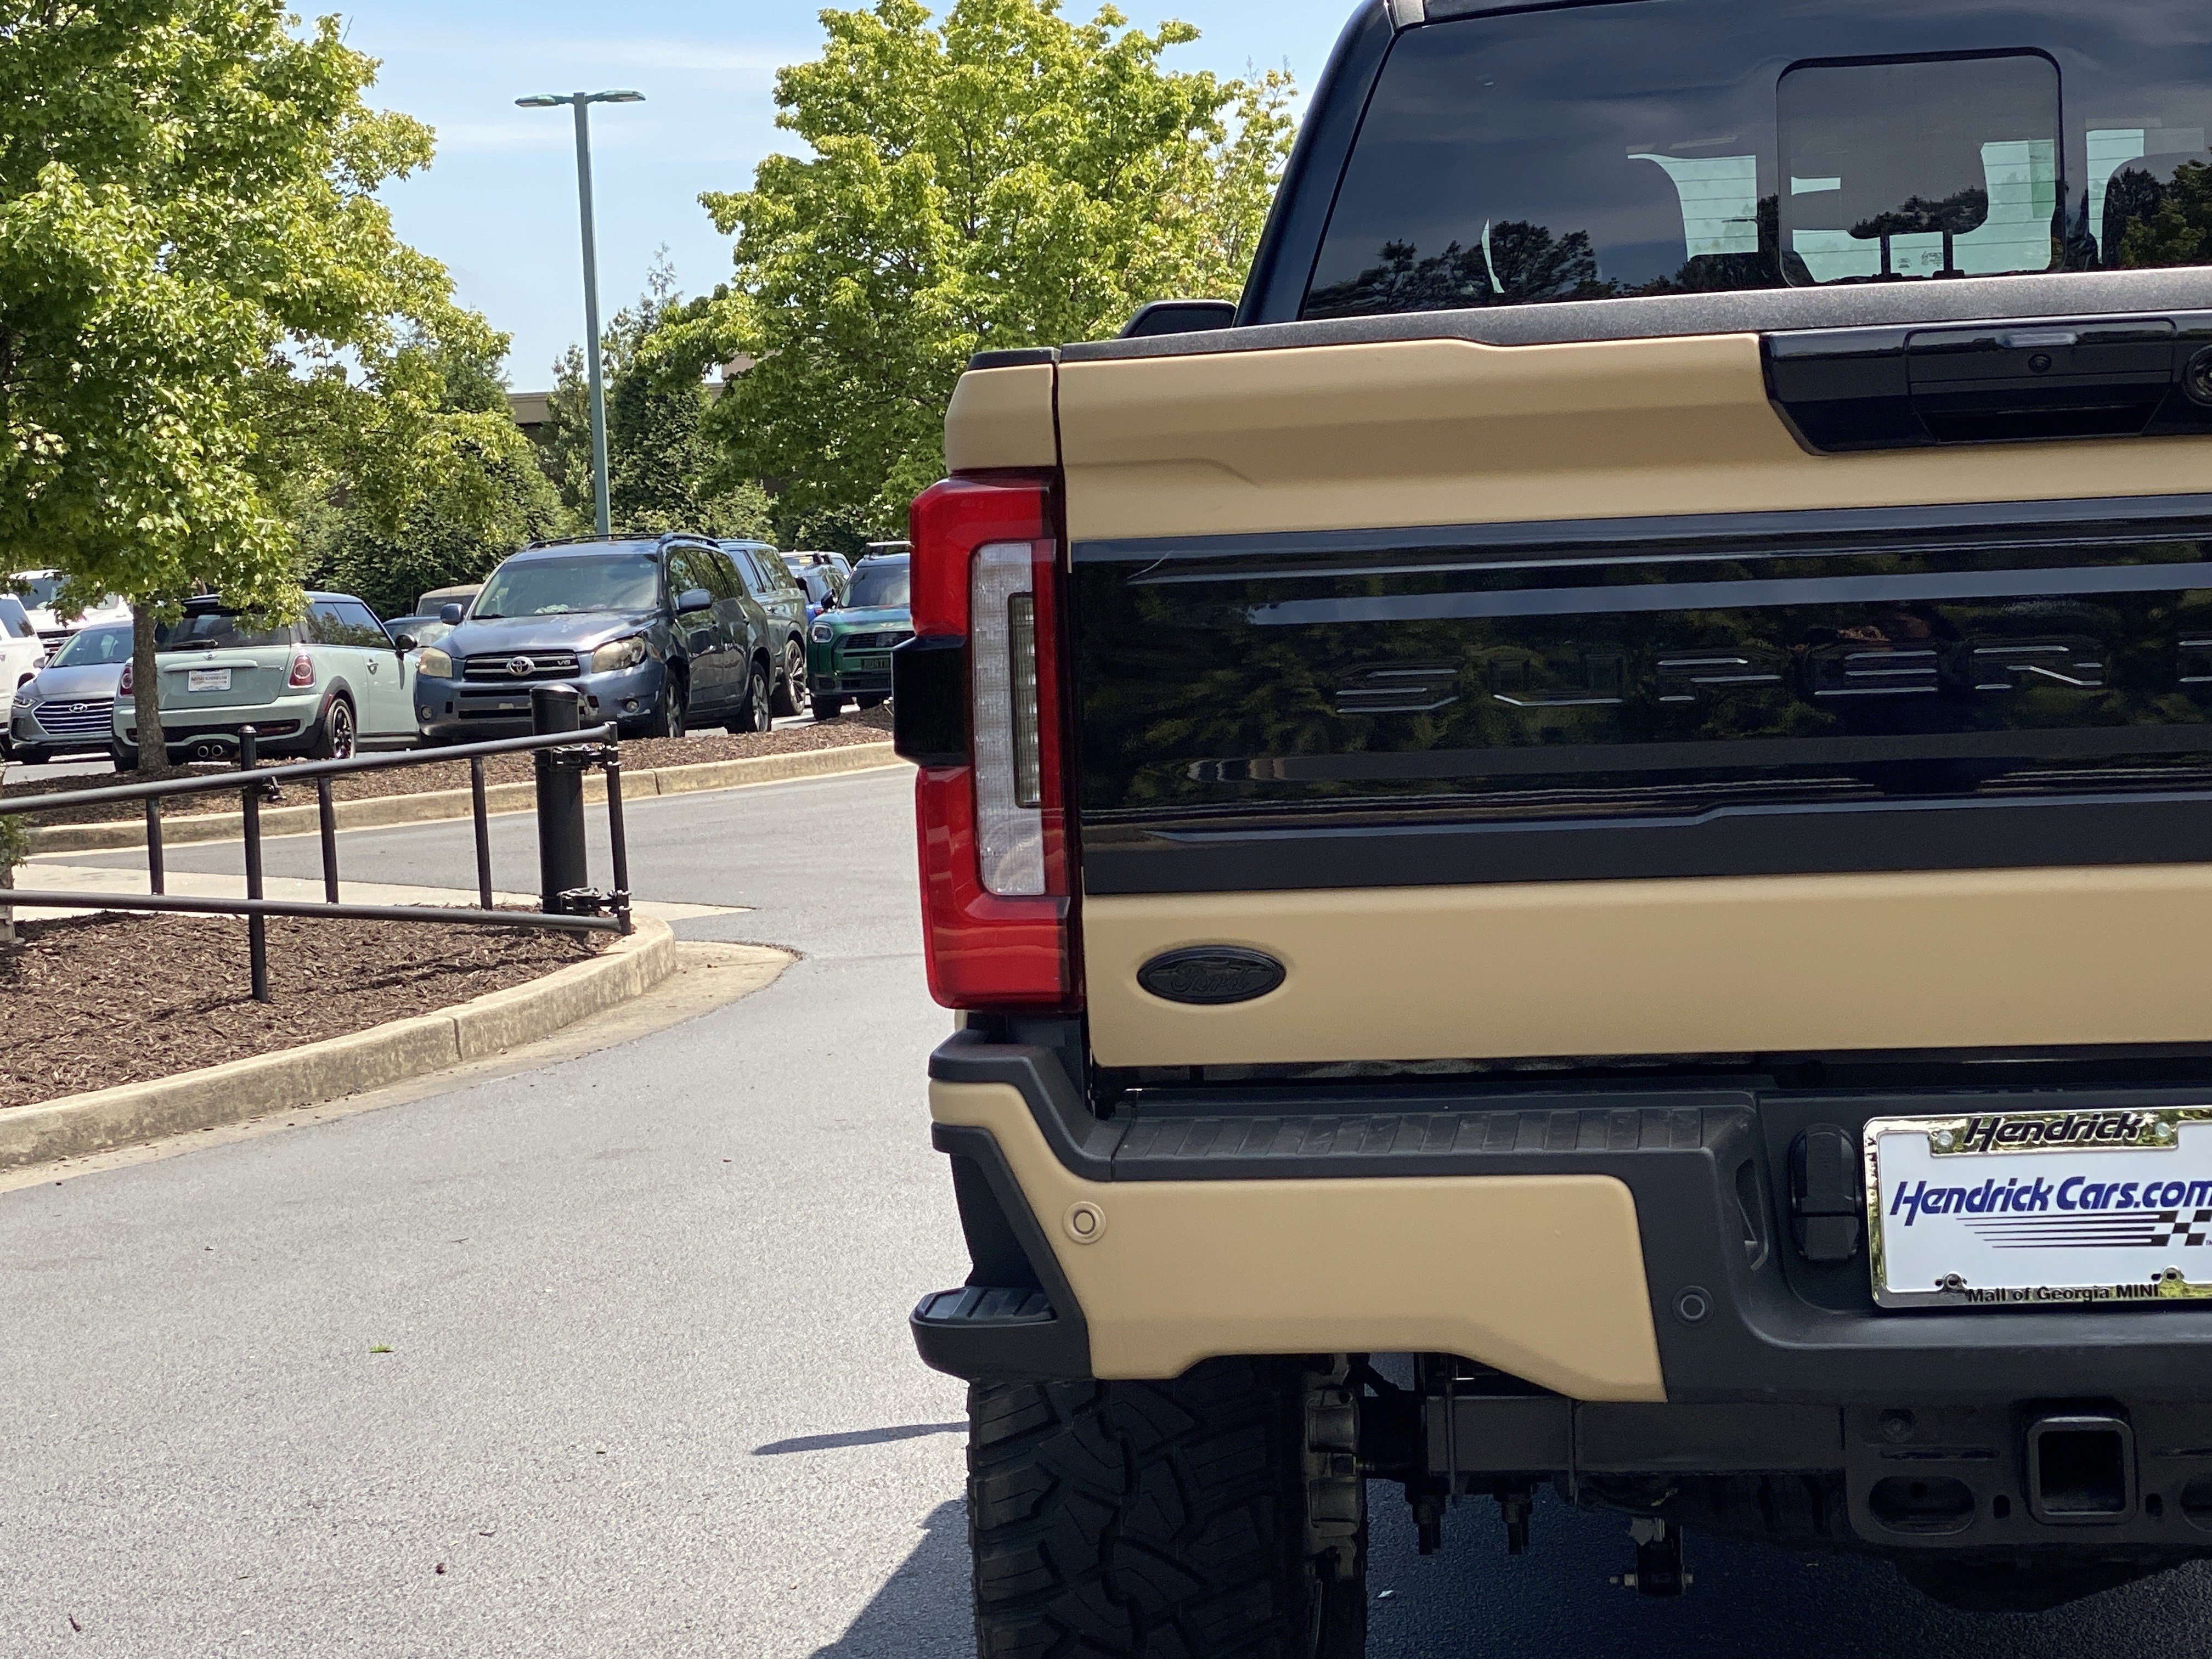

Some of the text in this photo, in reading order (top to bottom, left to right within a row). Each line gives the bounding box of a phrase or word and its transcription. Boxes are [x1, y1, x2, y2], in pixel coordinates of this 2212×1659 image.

[1170, 960, 1250, 992] Ford
[1963, 1112, 2143, 1153] Hendrick
[1966, 1284, 2158, 1302] Mall of Georgia MINI
